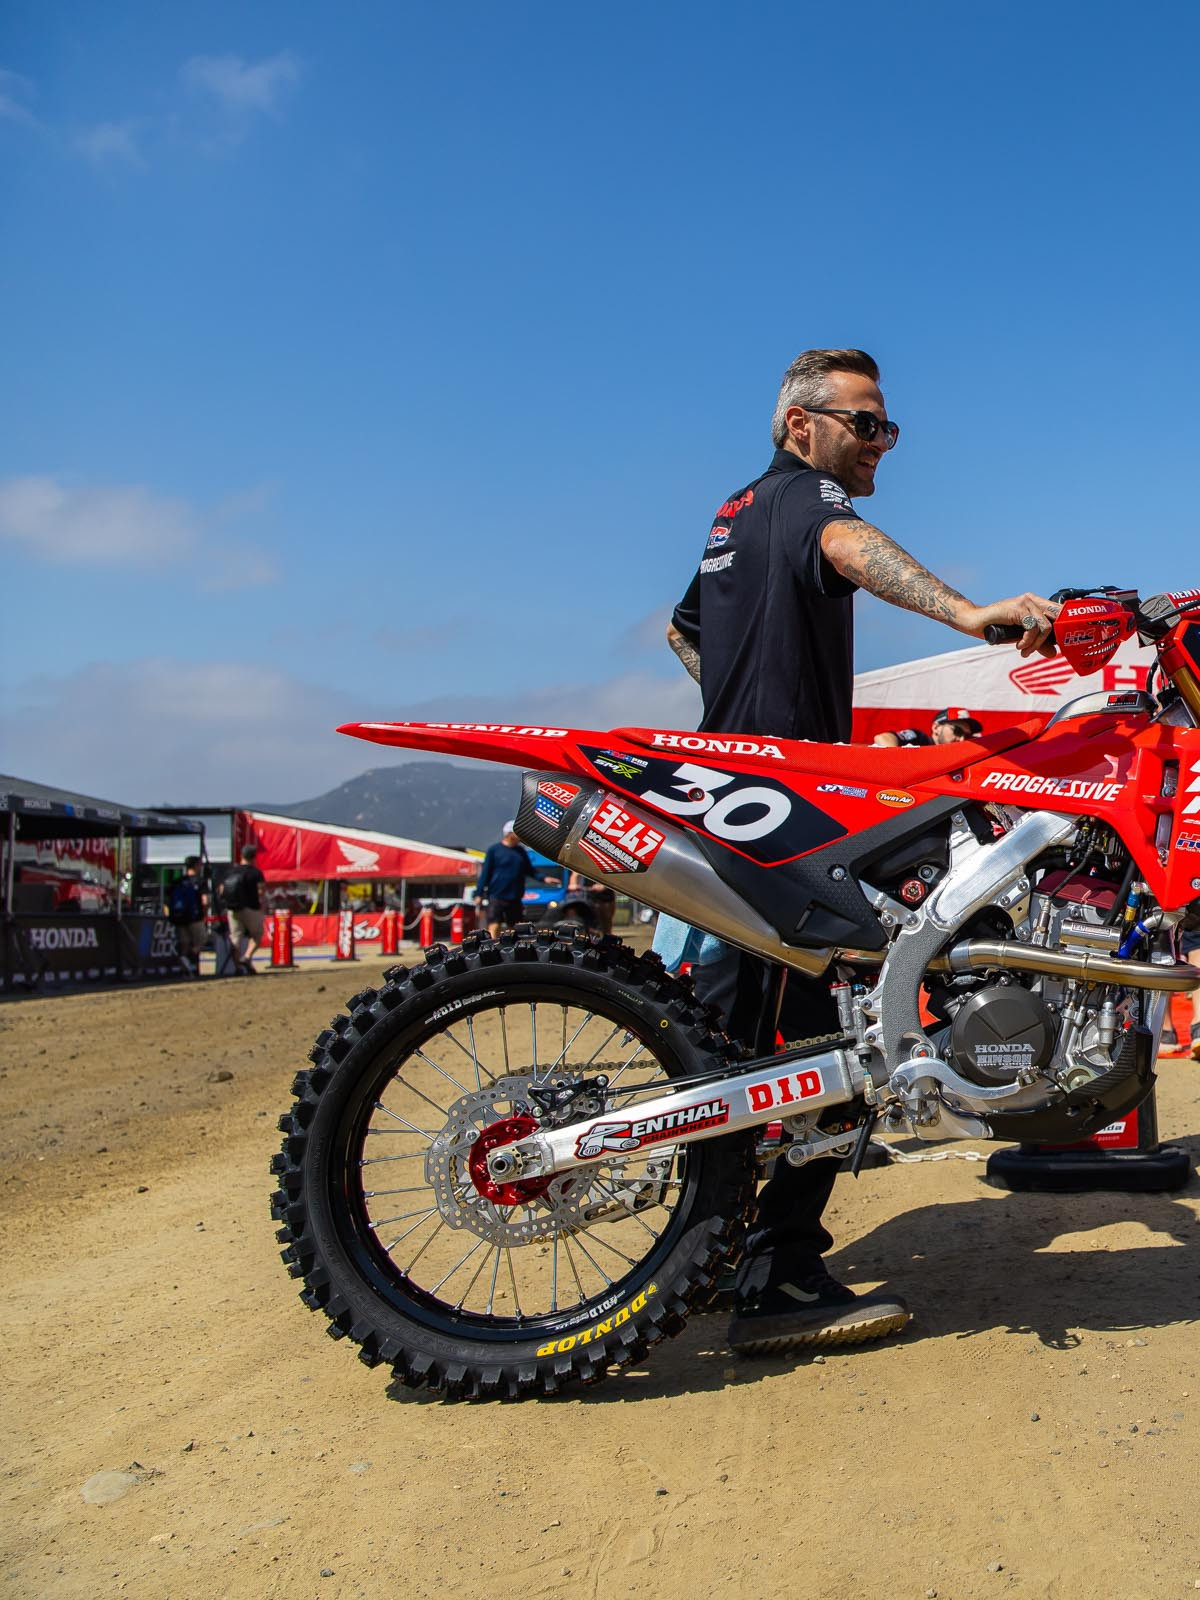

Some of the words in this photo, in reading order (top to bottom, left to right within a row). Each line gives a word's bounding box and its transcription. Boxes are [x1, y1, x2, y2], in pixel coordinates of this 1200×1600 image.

[1067, 605, 1108, 617] HONDA
[651, 733, 786, 760] HONDA
[880, 792, 899, 802] Twin
[980, 772, 1125, 802] PROGRESSIVE
[640, 762, 792, 842] 30
[591, 803, 663, 858] ヨシムラ
[585, 830, 640, 871] YOSHIMURA
[31, 927, 99, 949] HONDA
[974, 1043, 1036, 1054] HONDA
[976, 1054, 1032, 1064] HINSON
[536, 1290, 648, 1357] DUNLOP
